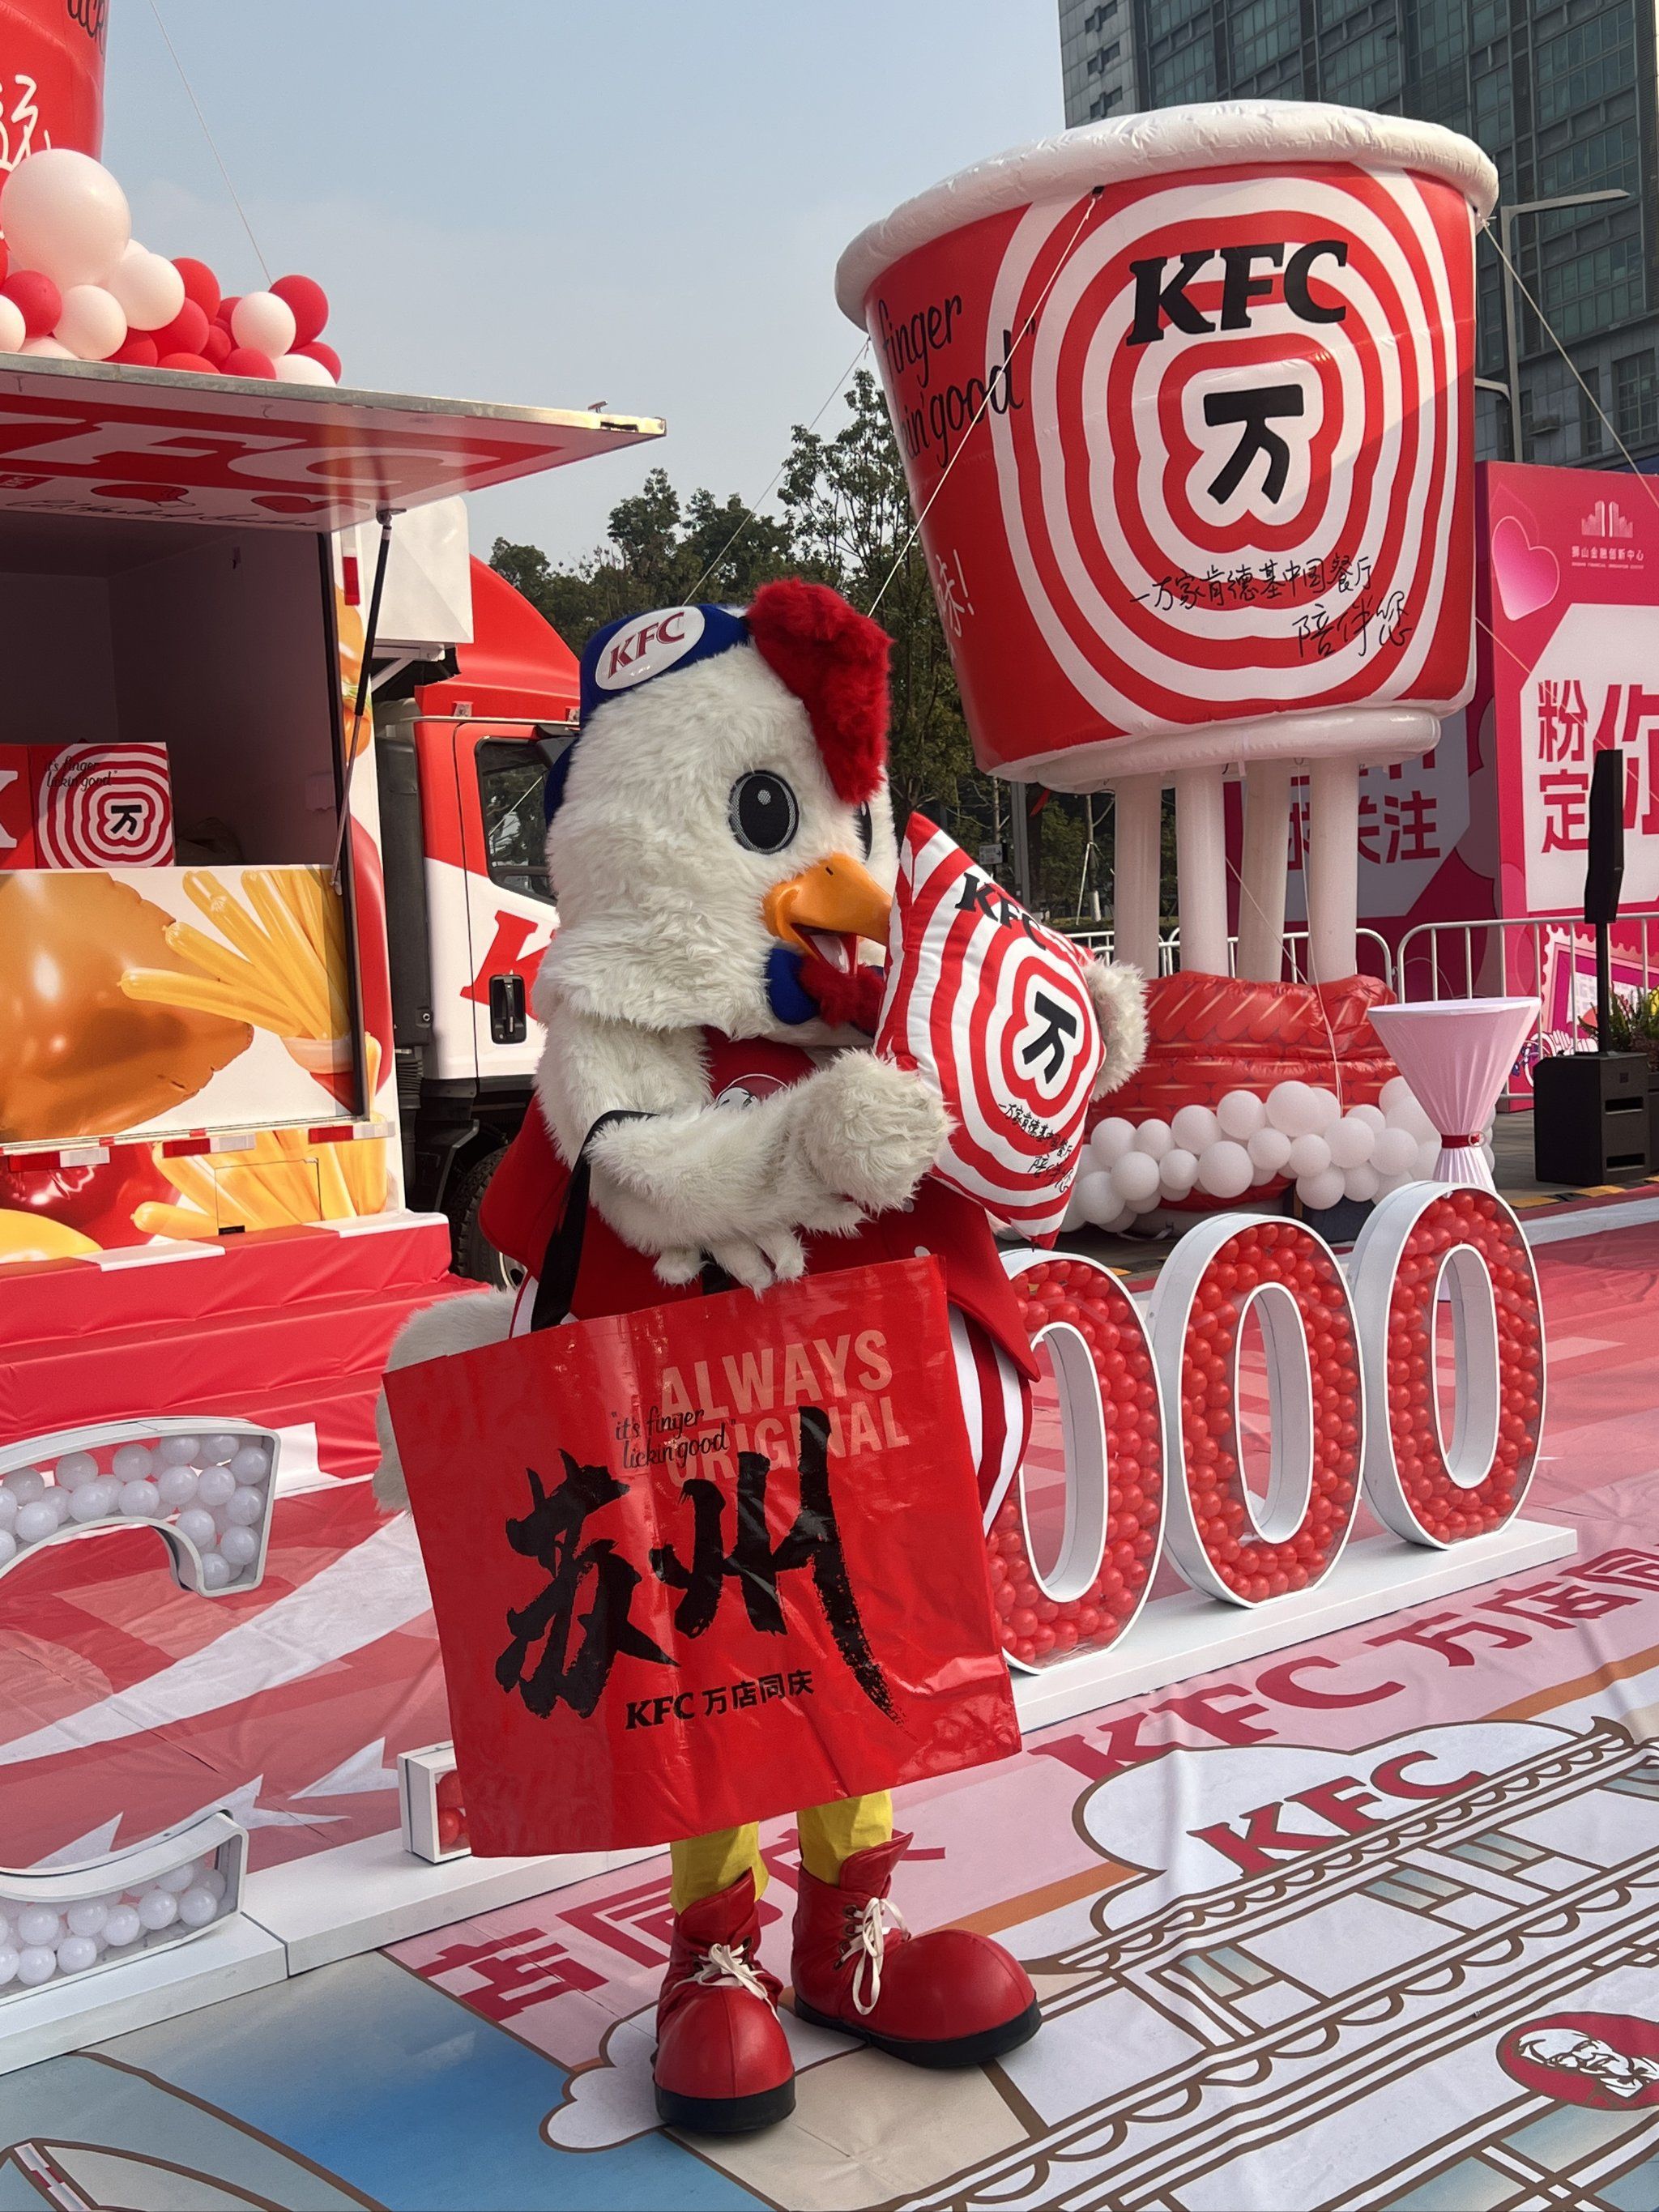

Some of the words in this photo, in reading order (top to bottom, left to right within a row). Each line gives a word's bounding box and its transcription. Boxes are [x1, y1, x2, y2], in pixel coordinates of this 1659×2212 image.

[1127, 241, 1348, 346] KFC
[879, 295, 962, 389] finger
[1204, 384, 1305, 505] 万
[1130, 552, 1373, 612] 一万家肯德基中国餐厅
[1292, 590, 1413, 658] 陪伴您
[608, 612, 685, 680] KFC
[954, 872, 1047, 951] KFC
[662, 1329, 893, 1422] ALWAYS
[646, 1405, 705, 1440] finger
[495, 1405, 917, 1743] 苏州
[625, 1692, 695, 1730] KFC
[702, 1669, 814, 1717] 万店同庆
[1027, 1655, 1406, 1782] KFC
[1362, 1542, 1659, 1667] 万店同
[1187, 1750, 1491, 1880] KFC
